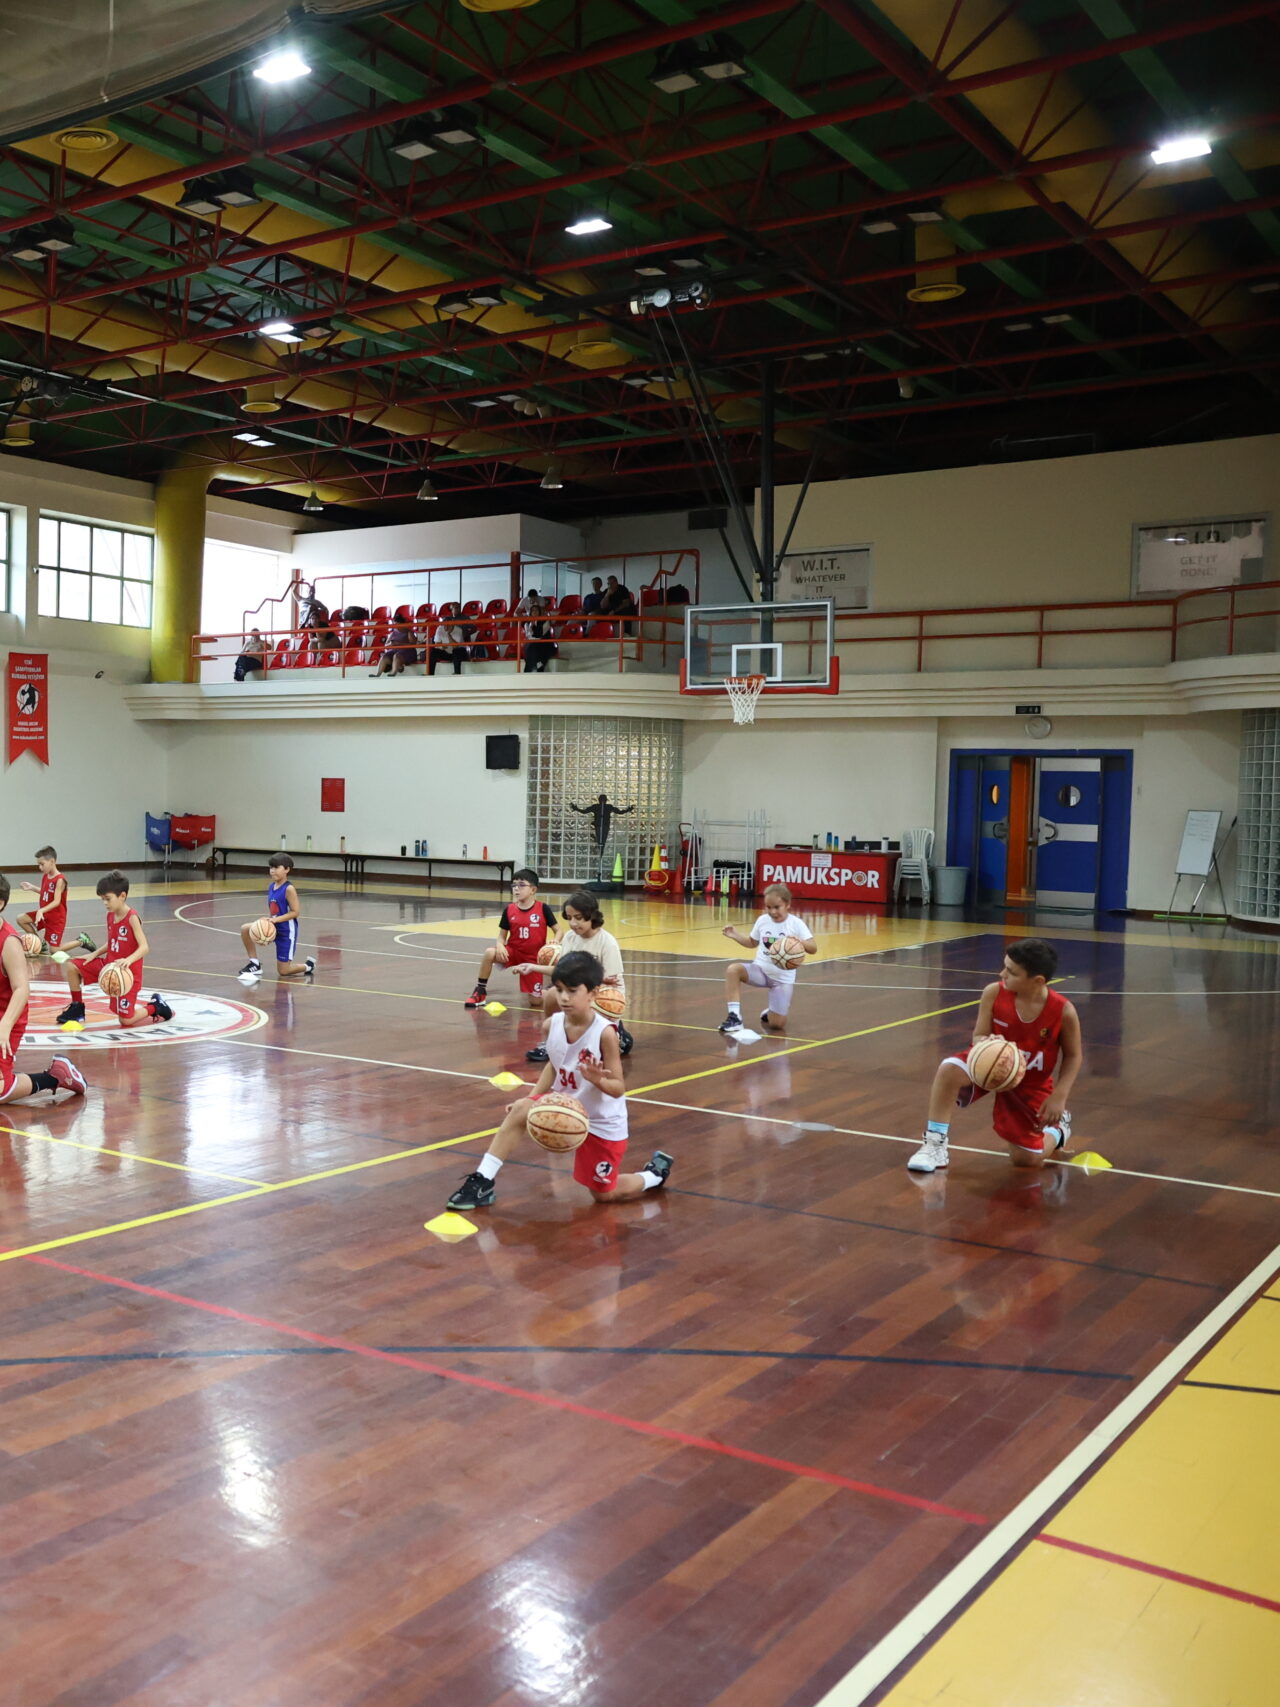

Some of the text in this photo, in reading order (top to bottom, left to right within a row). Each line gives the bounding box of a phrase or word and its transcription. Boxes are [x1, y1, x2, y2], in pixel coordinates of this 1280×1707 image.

[802, 558, 840, 571] W.I.T.
[1180, 553, 1218, 565] GET IT
[795, 573, 846, 584] WHATEVER
[815, 585, 824, 593] IT
[762, 864, 880, 889] PAMUKSPOR
[518, 926, 529, 939] 16
[558, 1067, 577, 1090] 34
